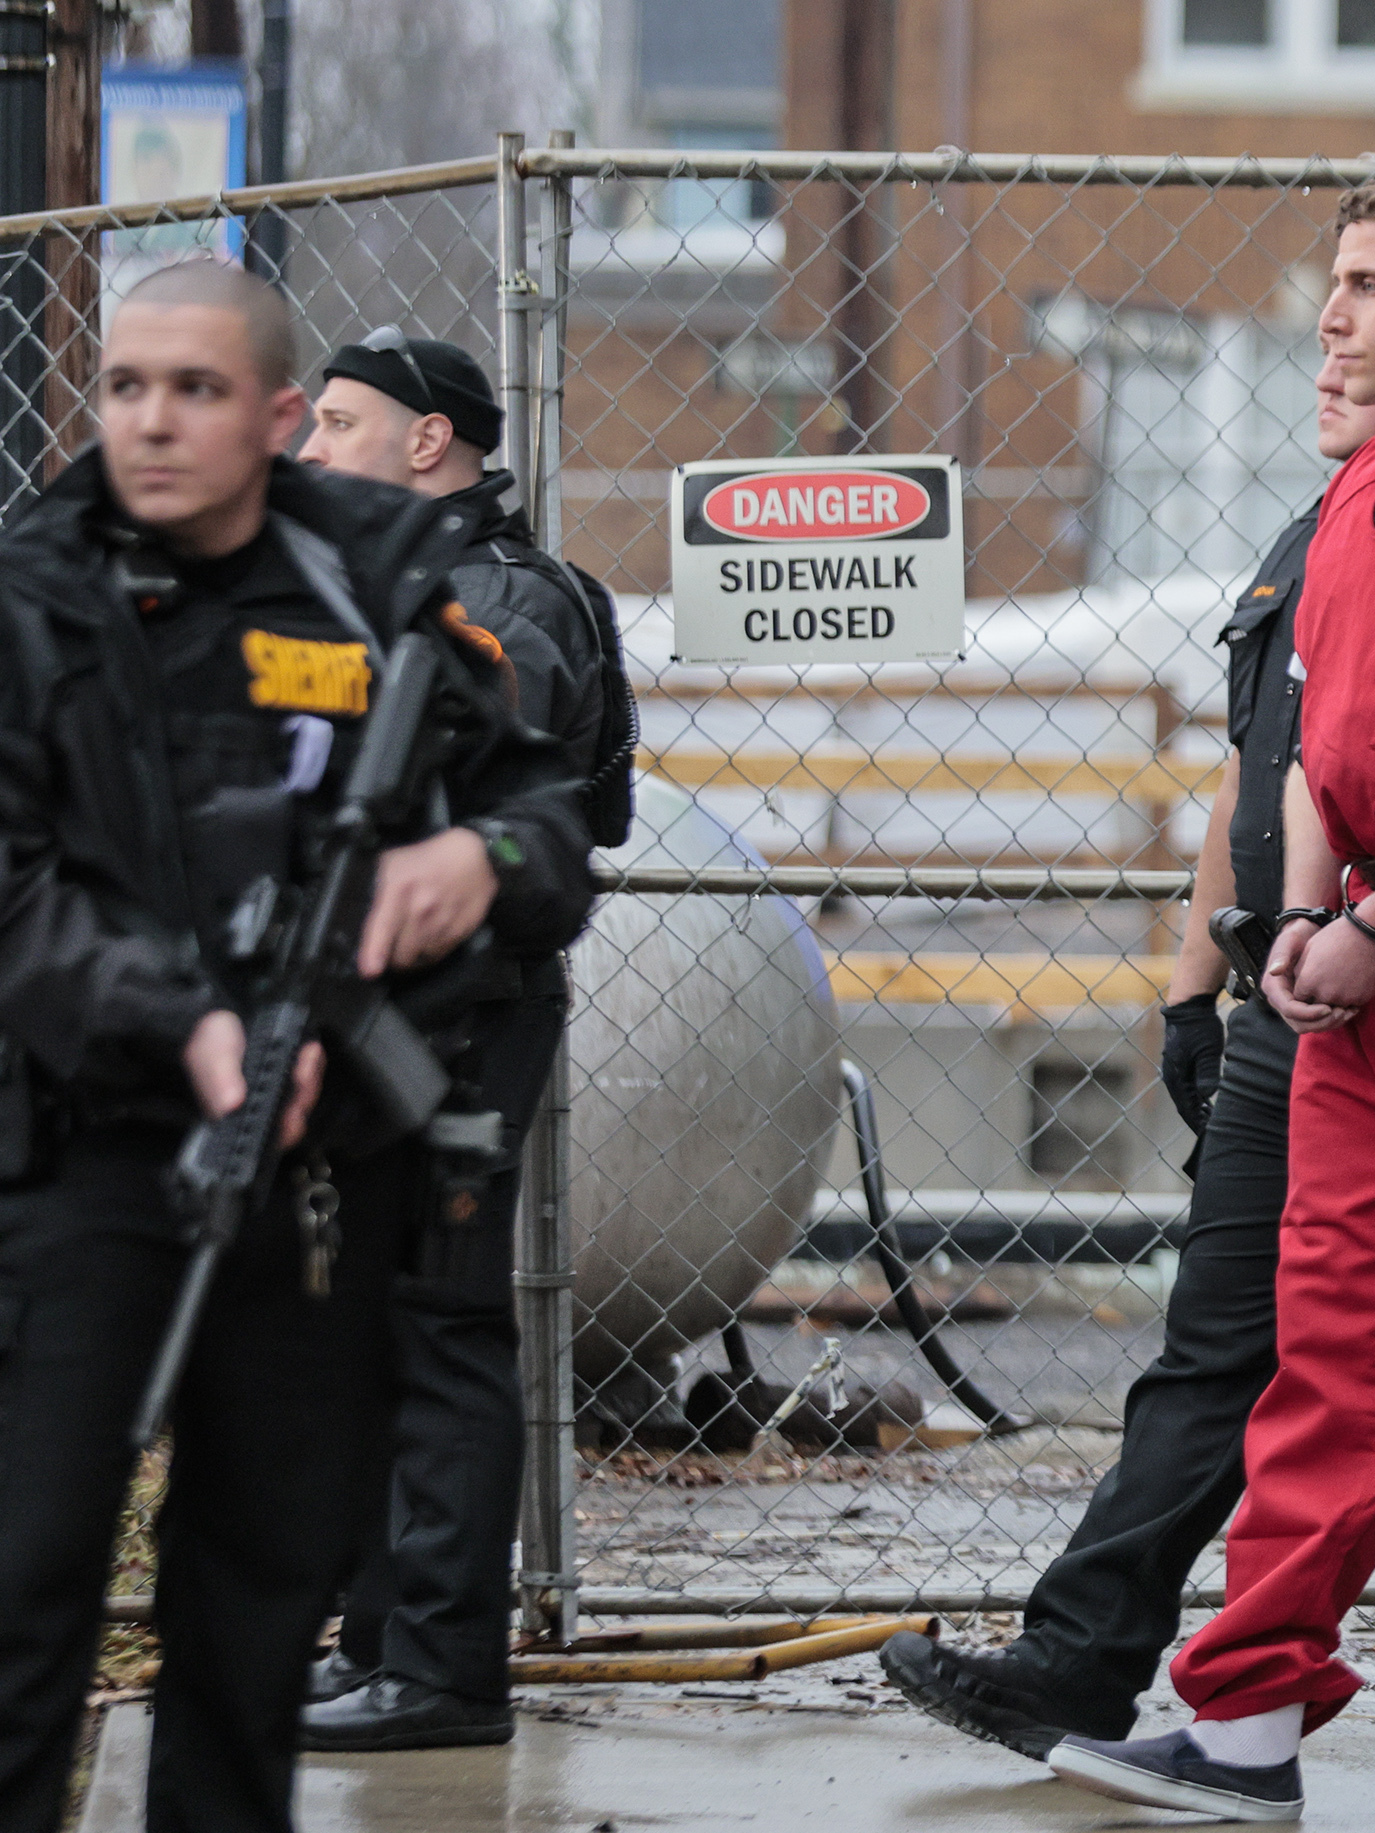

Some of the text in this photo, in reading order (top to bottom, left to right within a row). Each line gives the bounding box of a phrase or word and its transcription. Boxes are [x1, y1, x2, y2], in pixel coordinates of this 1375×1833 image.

[733, 486, 899, 526] DANGER
[719, 555, 918, 593] SIDEWALK
[744, 606, 896, 642] CLOSED
